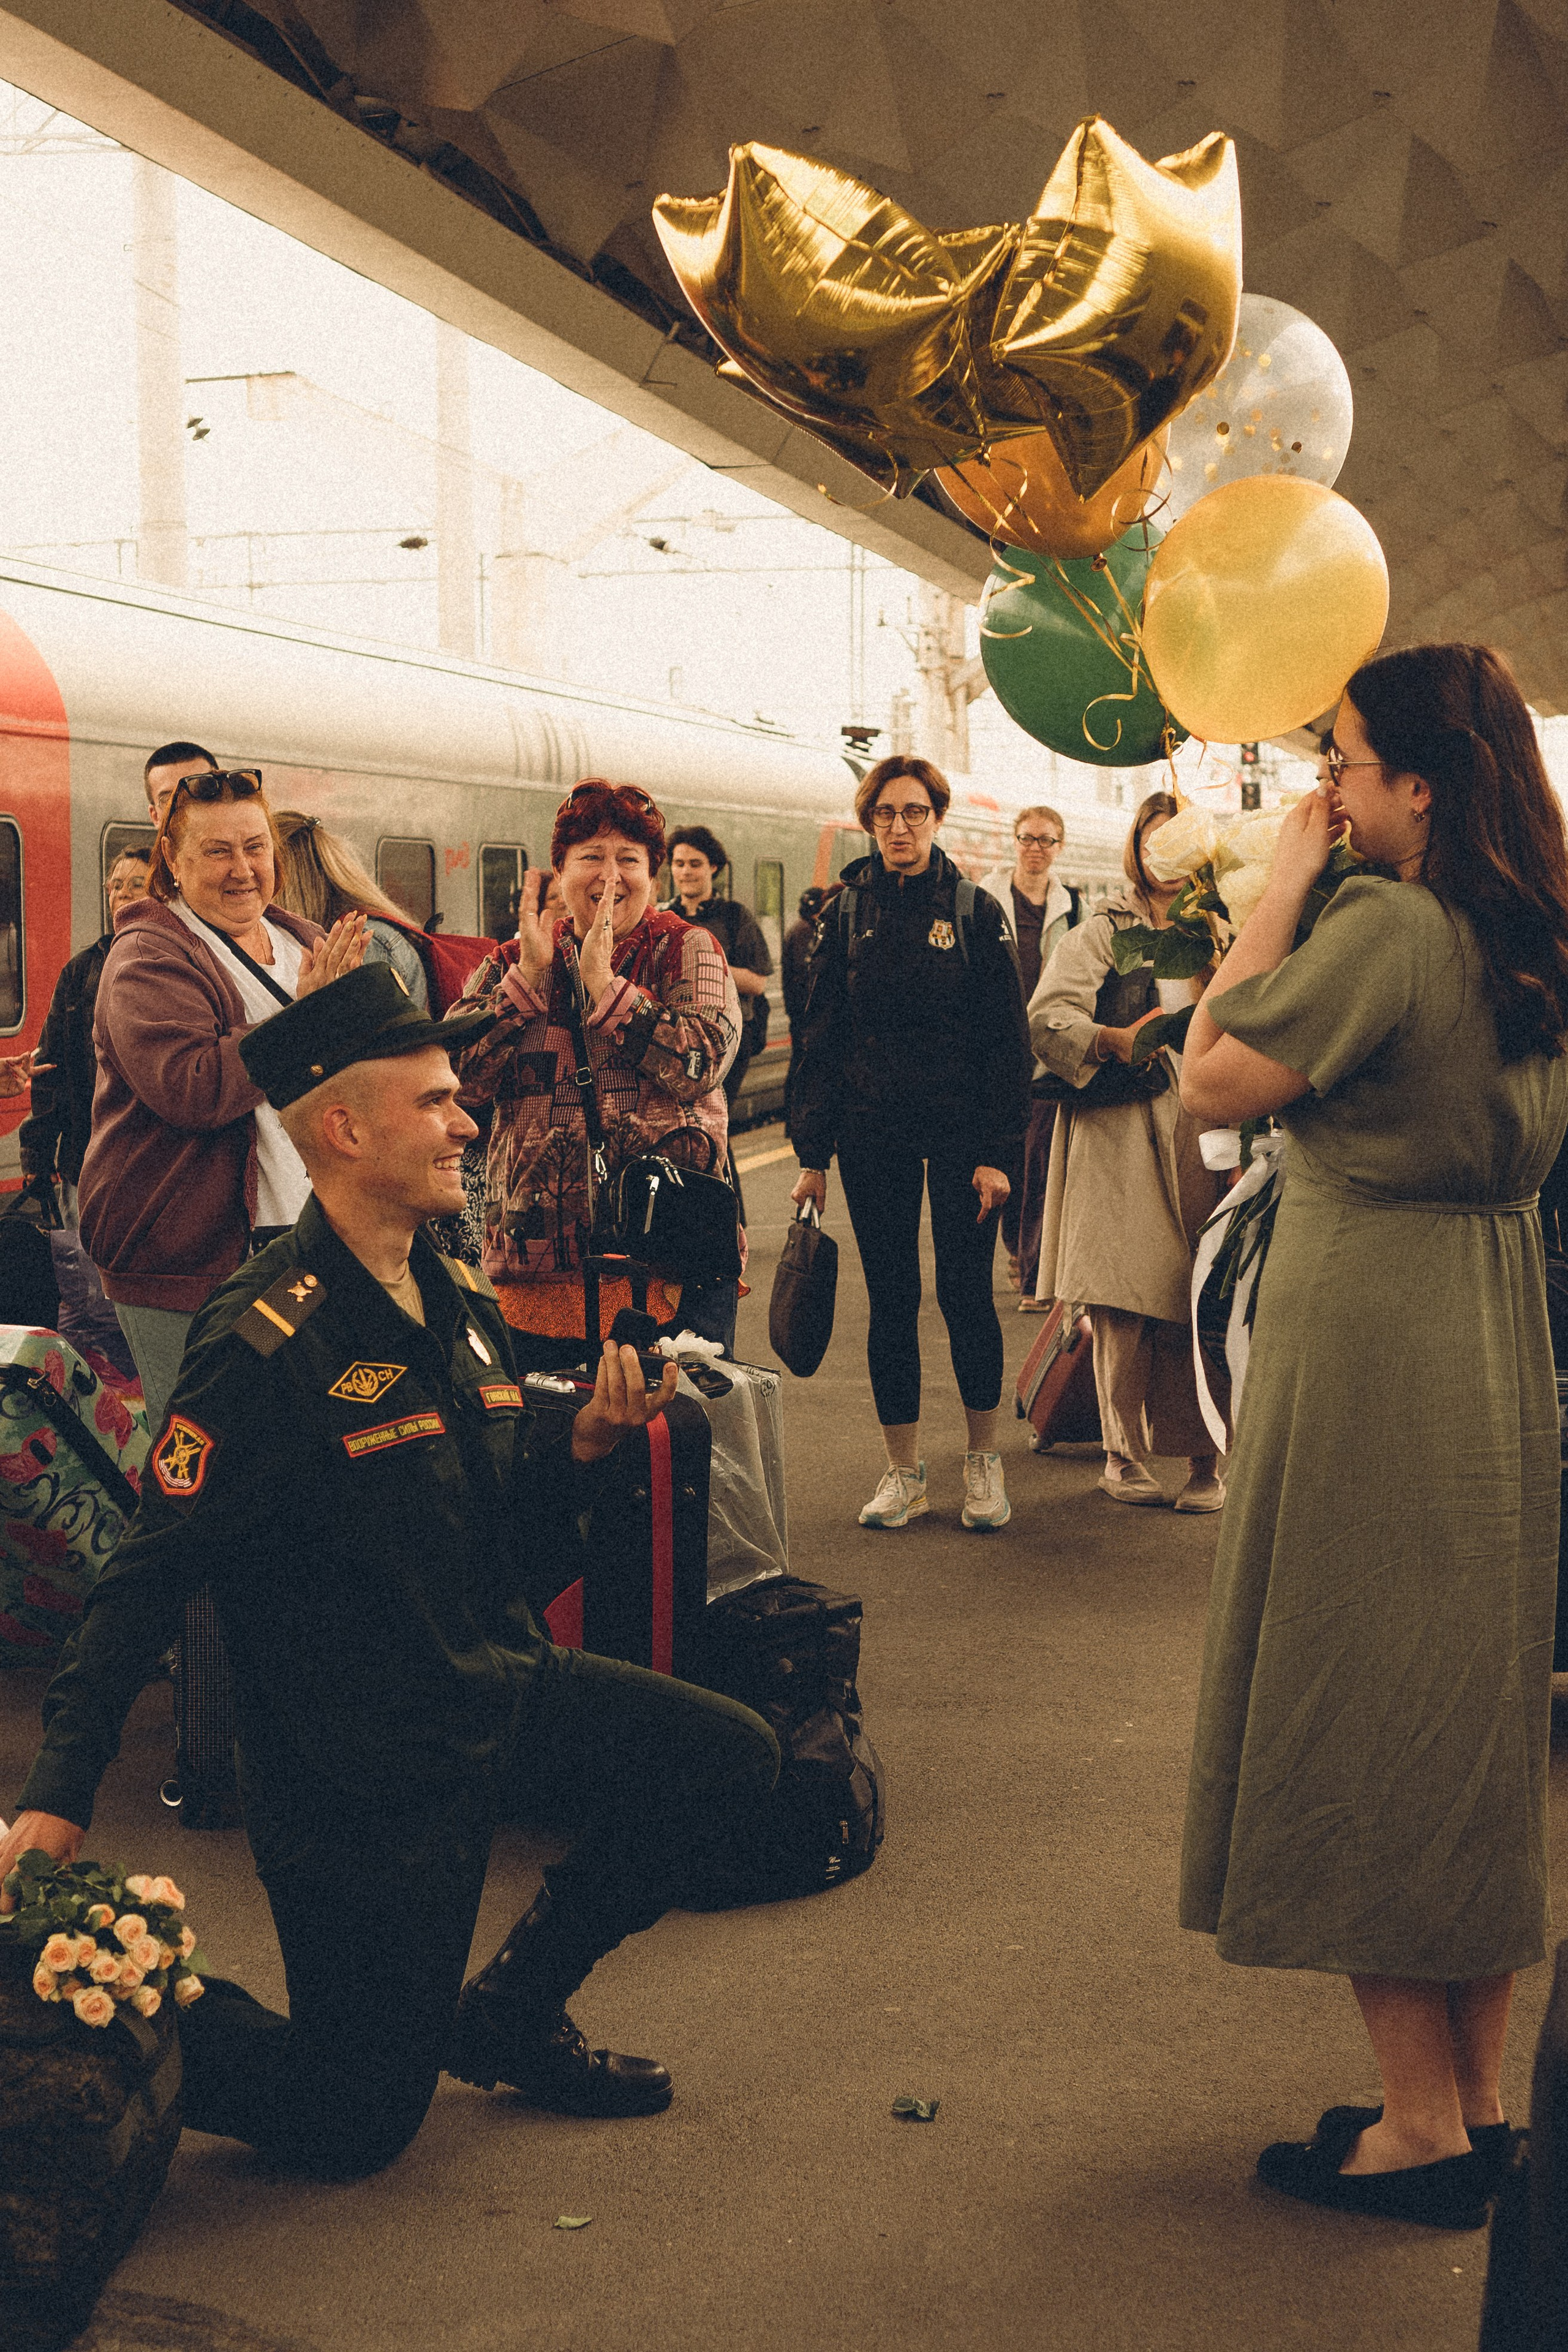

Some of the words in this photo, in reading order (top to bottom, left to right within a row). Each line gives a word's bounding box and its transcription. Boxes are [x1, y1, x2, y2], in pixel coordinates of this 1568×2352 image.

[341, 1382, 354, 1395] РВ
[378, 1368, 393, 1381] СН
[348, 1428, 399, 1452] ВООРУЖЕННЫЕ
[398, 1421, 418, 1436] СИЛЫ
